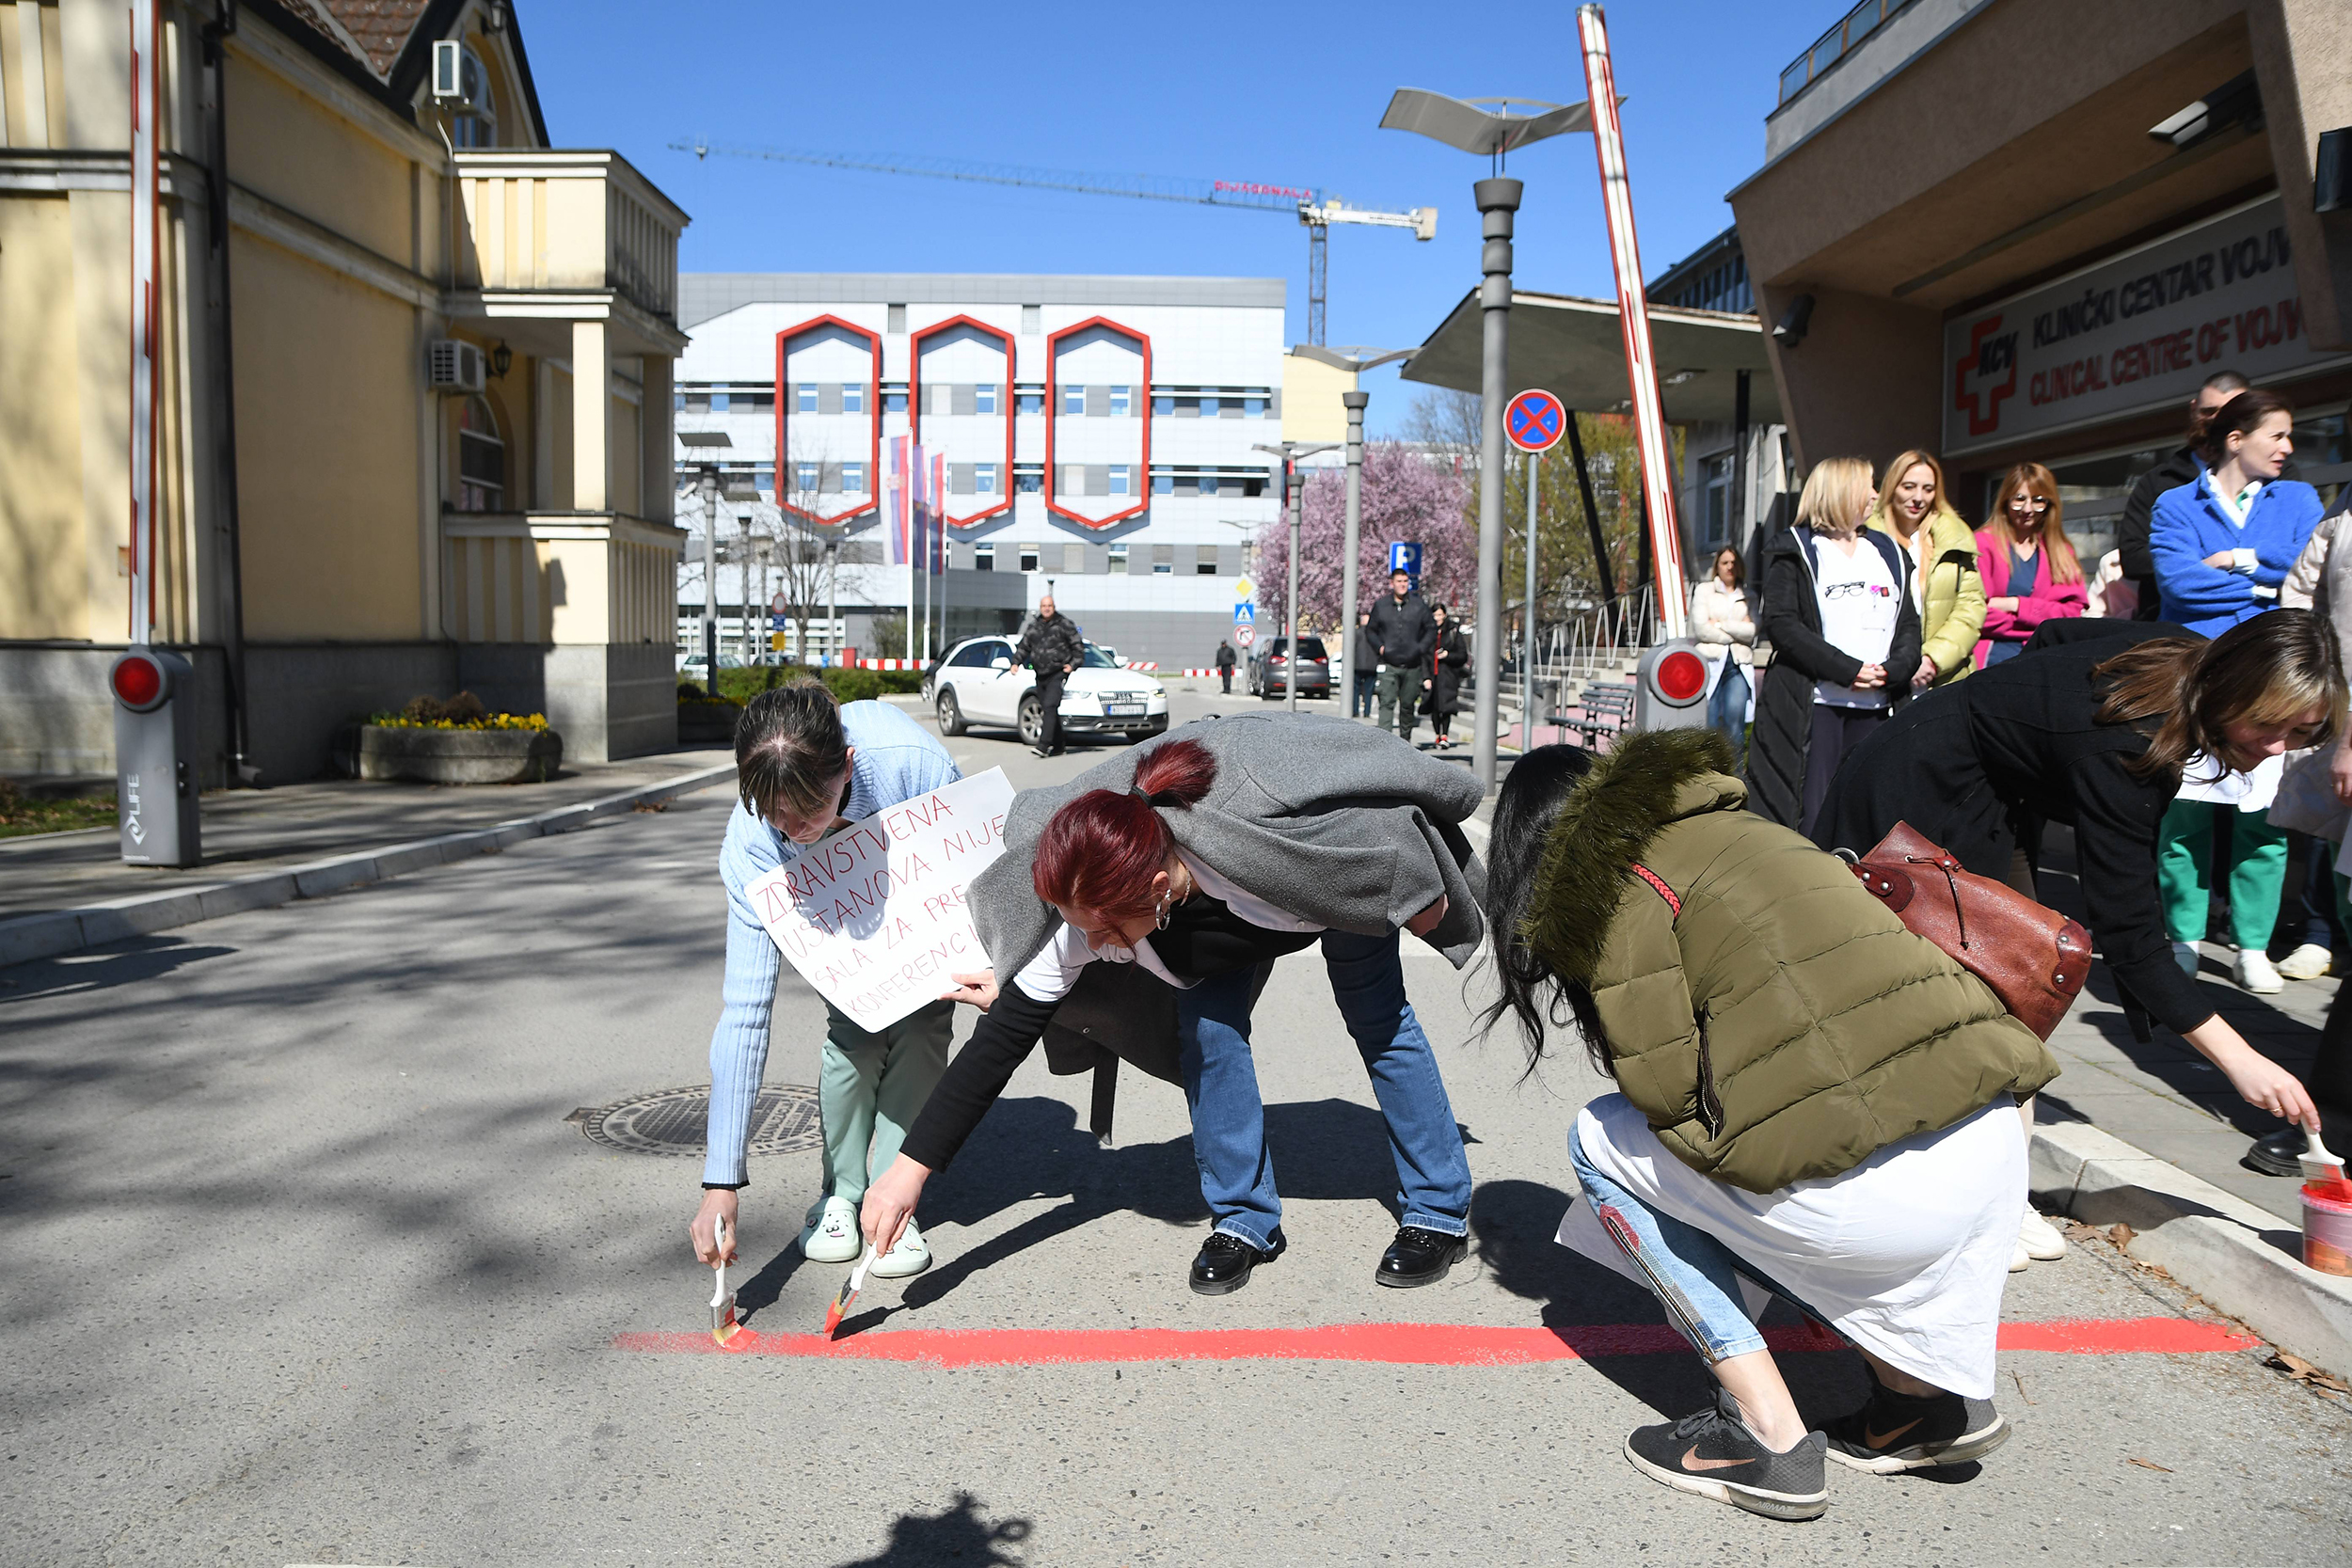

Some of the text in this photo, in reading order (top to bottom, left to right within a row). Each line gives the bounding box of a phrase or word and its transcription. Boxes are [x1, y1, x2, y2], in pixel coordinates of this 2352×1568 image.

[2032, 286, 2115, 350] KLINIČKI
[2120, 252, 2215, 320] CENTAR
[1978, 331, 2019, 378] KCV
[2029, 296, 2307, 407] CLINICAL CENTRE OF VOJV
[1395, 546, 1416, 569] P
[126, 772, 141, 816] LIFE
[755, 795, 953, 924] ZDRAVSTVENA
[783, 814, 1004, 958] USTANOVA NIJE
[815, 948, 873, 995] SALA
[882, 917, 913, 950] ZA
